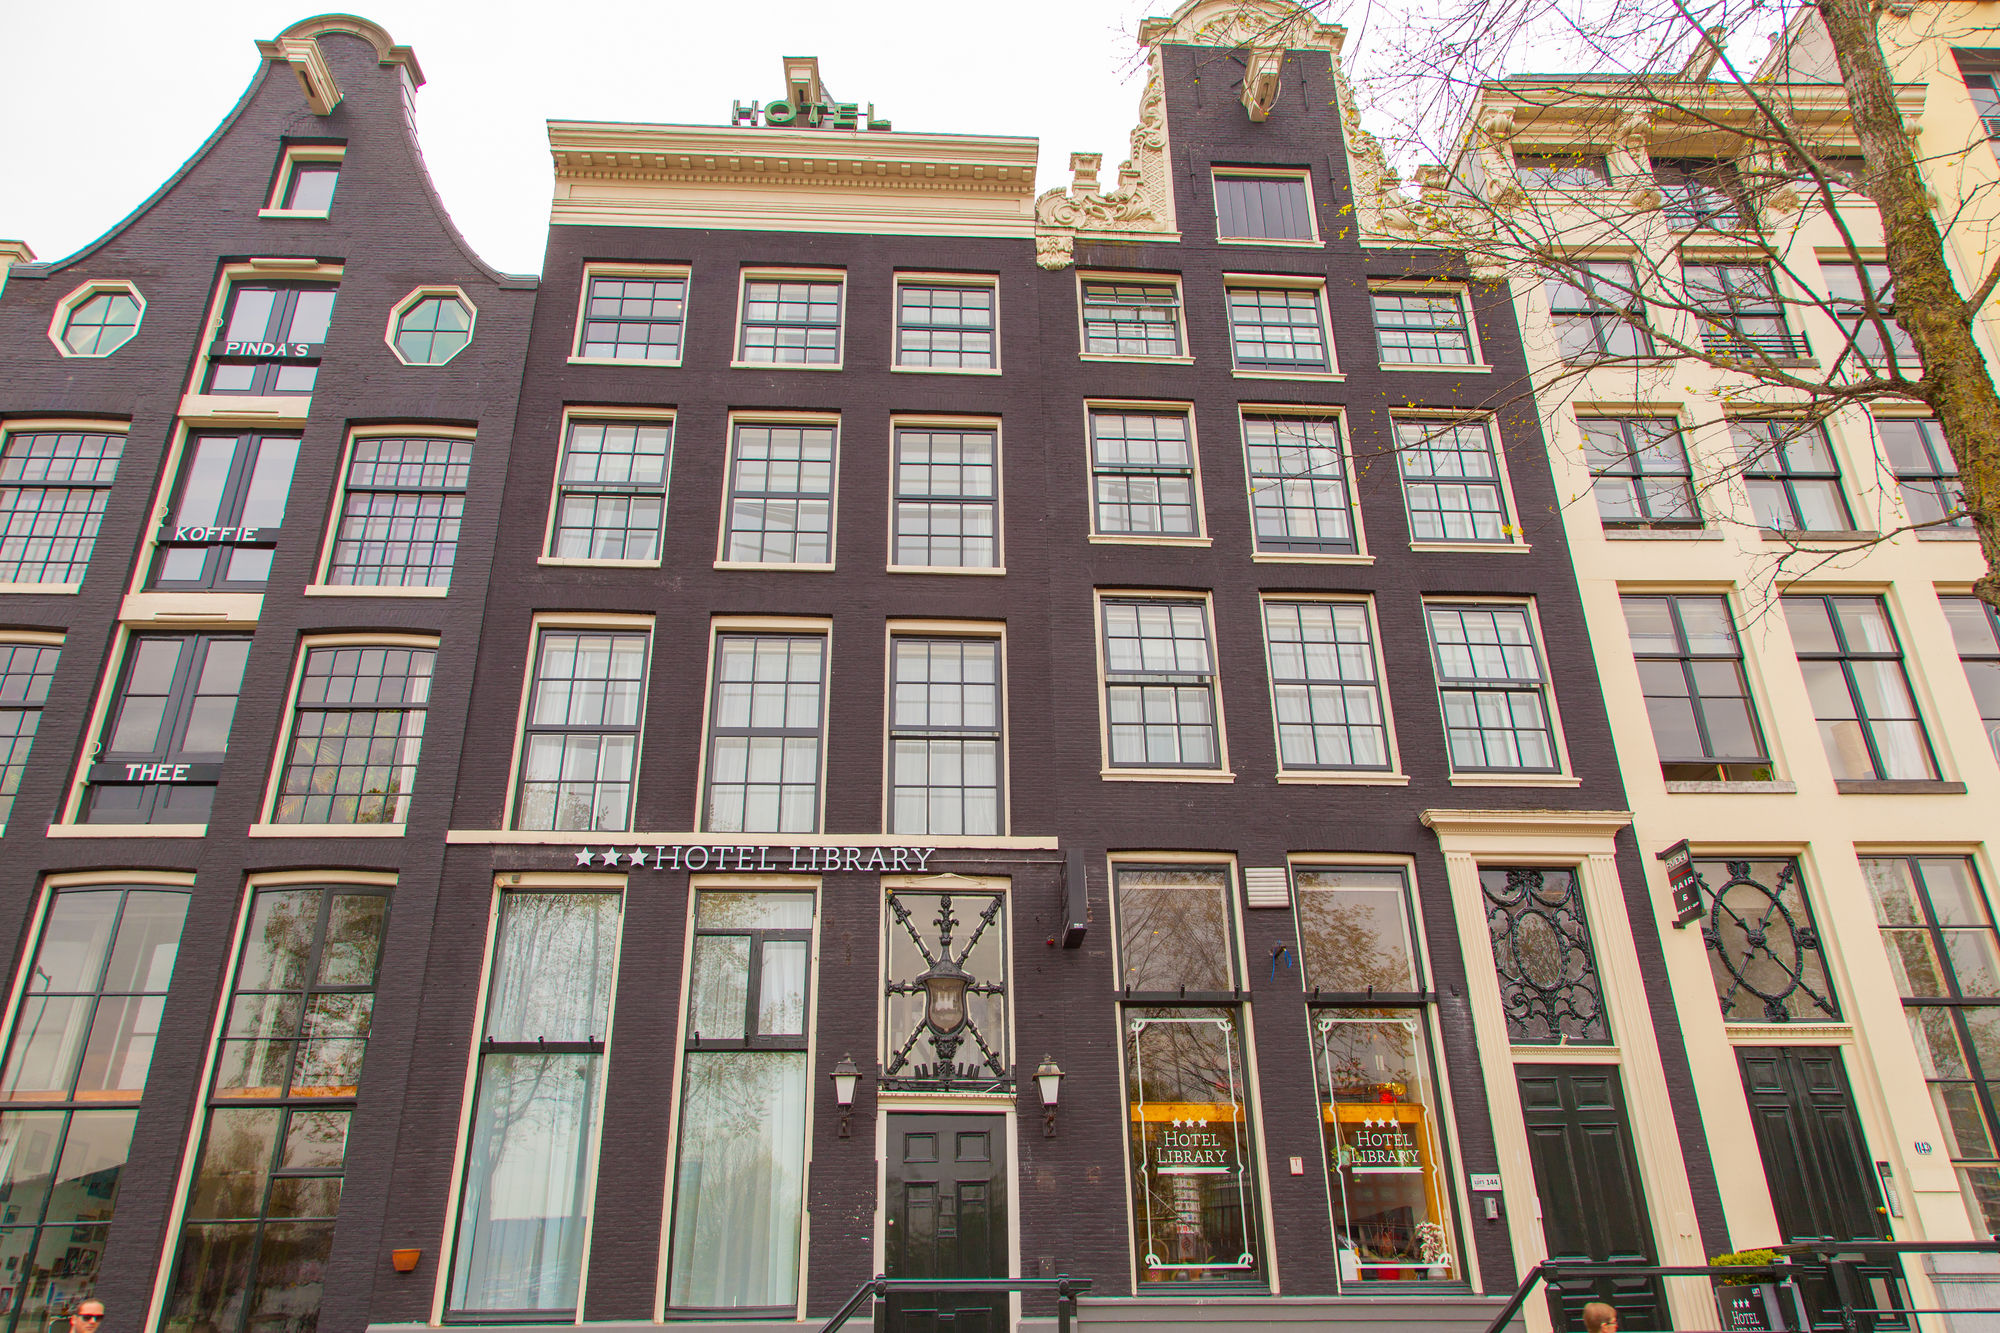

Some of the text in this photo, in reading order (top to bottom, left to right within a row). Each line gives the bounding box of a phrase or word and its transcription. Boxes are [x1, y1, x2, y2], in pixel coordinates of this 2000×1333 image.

[731, 99, 892, 131] HOTEL
[224, 342, 309, 357] PINDA'S
[174, 526, 259, 541] KOFFIE
[125, 763, 192, 781] THEE
[653, 846, 935, 872] HOTEL LIBRARY
[1671, 876, 1695, 893] HAIR
[1163, 1130, 1221, 1147] HOTEL
[1355, 1130, 1413, 1147] HOTEL
[1156, 1147, 1227, 1163] LIBRARY
[1351, 1147, 1420, 1163] LIBRARY
[1731, 1310, 1761, 1325] HOTEL
